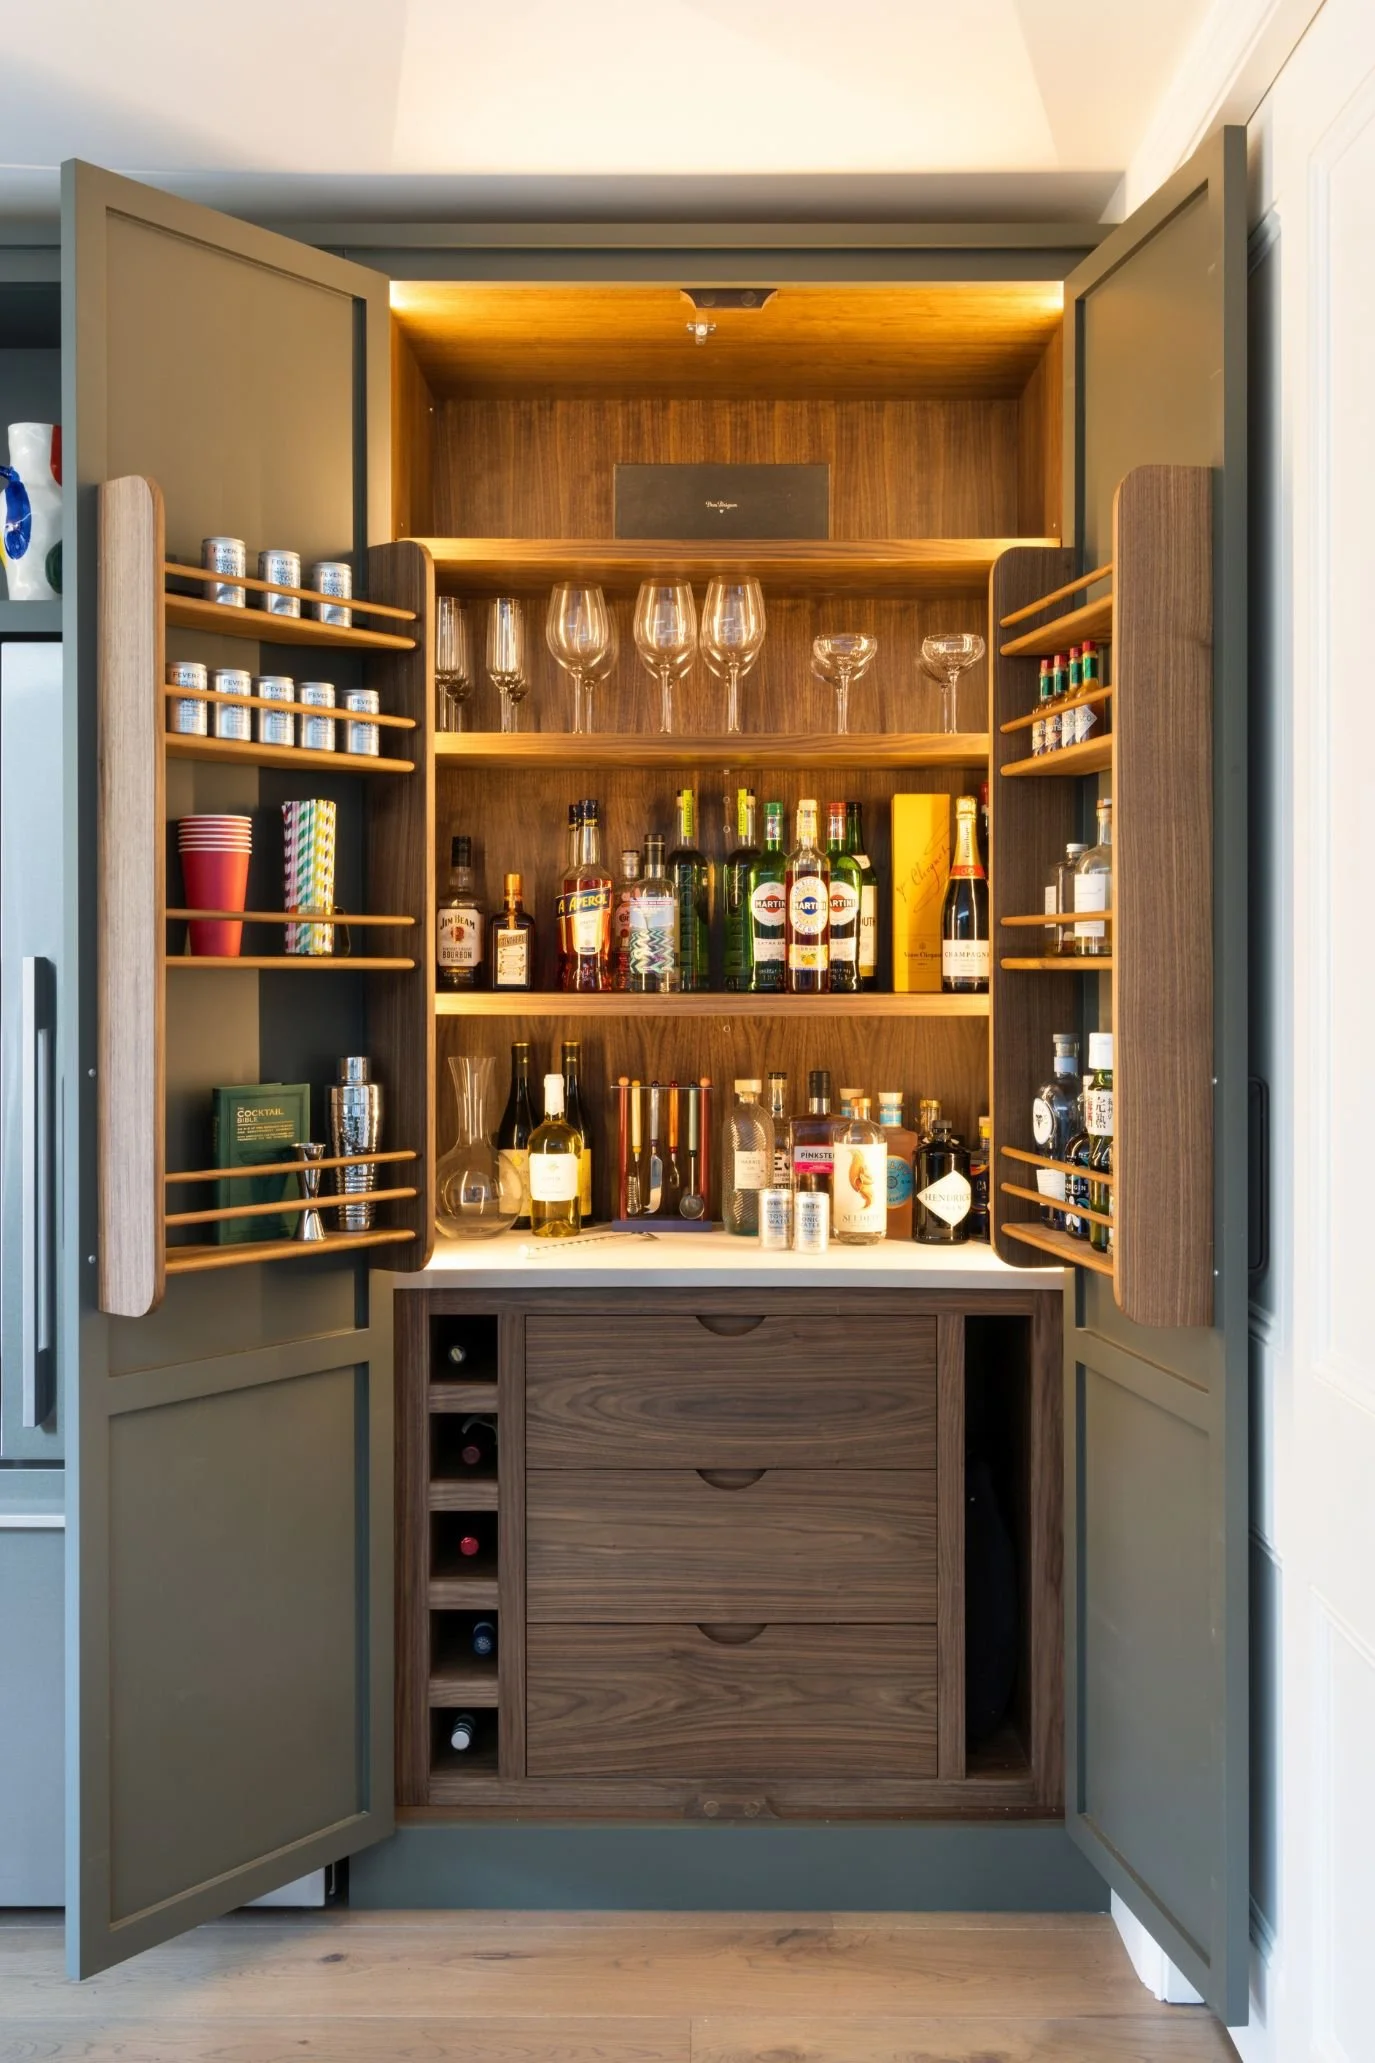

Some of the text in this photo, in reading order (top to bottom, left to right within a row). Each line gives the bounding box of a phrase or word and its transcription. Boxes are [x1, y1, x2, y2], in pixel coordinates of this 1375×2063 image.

[755, 900, 785, 908] MARTIN
[440, 914, 475, 930] JIM BEAM
[237, 1108, 284, 1117] COCKTAIL
